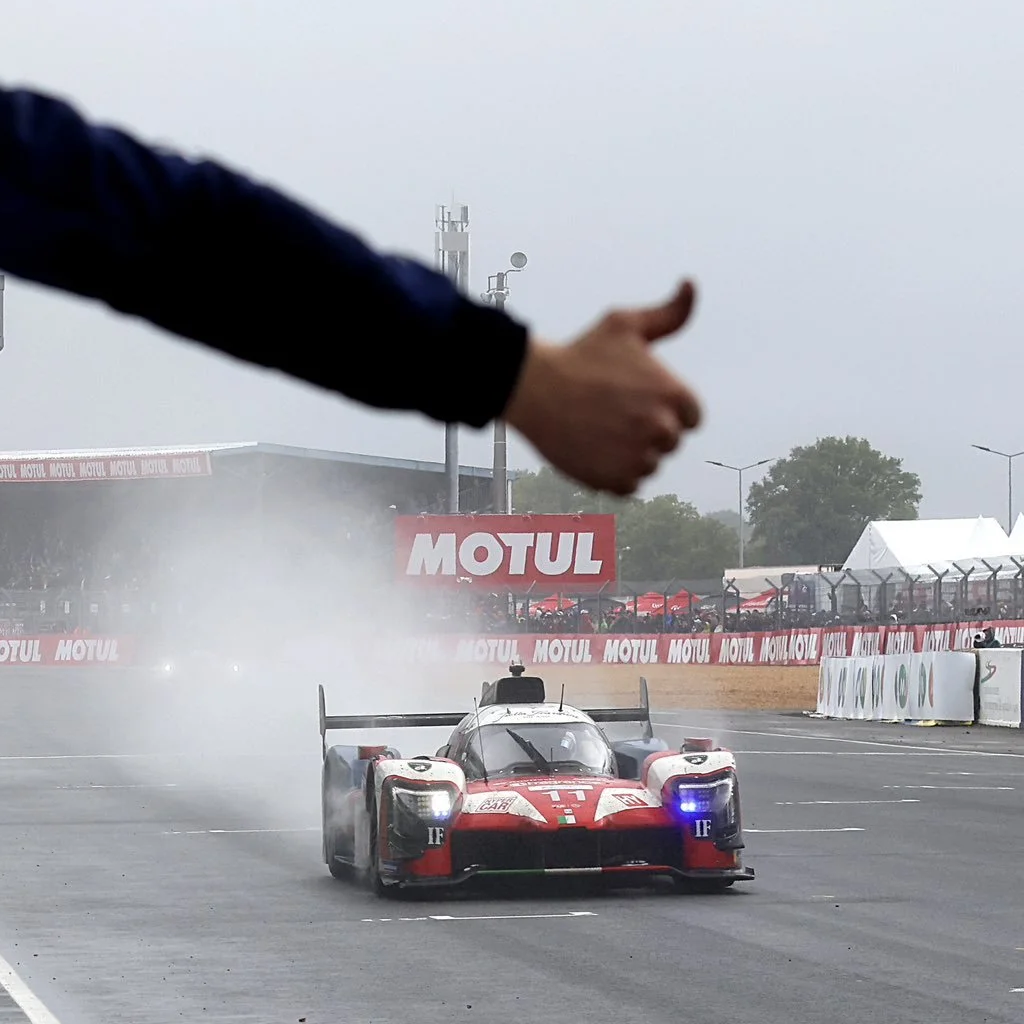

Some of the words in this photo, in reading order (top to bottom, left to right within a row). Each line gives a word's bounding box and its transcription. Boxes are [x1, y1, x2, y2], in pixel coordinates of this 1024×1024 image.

[20, 463, 46, 478] MOTUL
[50, 462, 75, 477] MOTUL
[79, 462, 106, 477] MOTUL
[110, 460, 137, 476] MOTUL
[141, 459, 168, 474] MOTUL
[173, 458, 201, 474] MOTUL
[406, 532, 603, 576] MOTUL
[55, 639, 118, 661] MOTUL
[455, 639, 520, 663] MOTUL
[533, 639, 592, 663] MOTUL
[603, 639, 658, 663] MOTUL
[667, 639, 711, 663] MOTUL
[719, 637, 754, 663] MOTUL
[760, 635, 788, 662] MOTUL
[542, 790, 586, 802] 11
[480, 802, 508, 811] CAR
[428, 827, 444, 845] IF
[696, 819, 711, 837] IF
